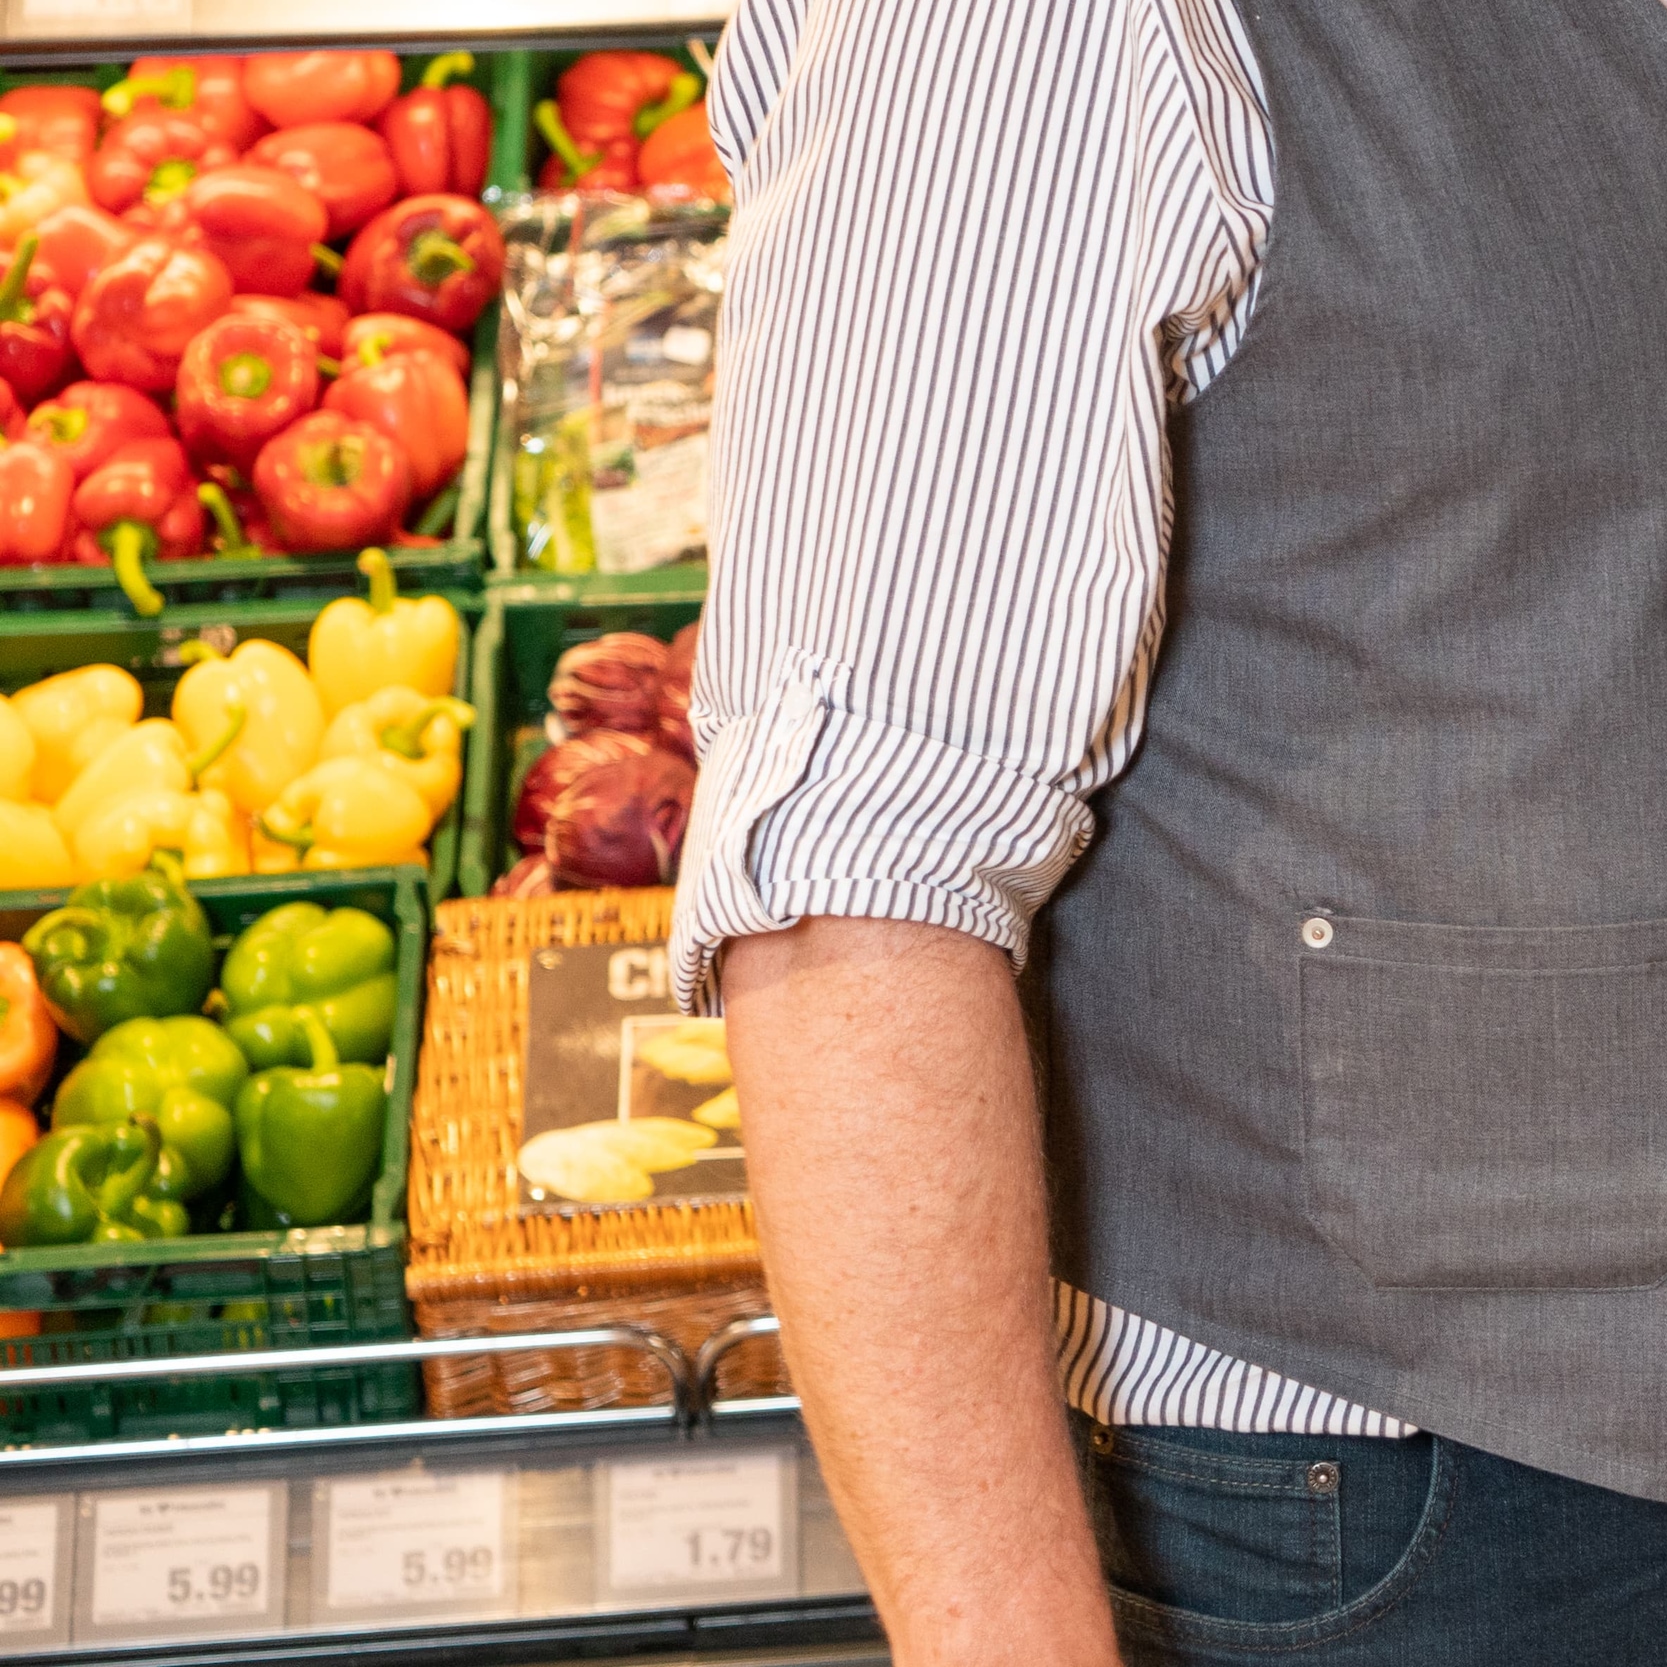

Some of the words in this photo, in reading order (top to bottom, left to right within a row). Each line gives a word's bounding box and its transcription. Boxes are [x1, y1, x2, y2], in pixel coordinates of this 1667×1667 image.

[402, 1545, 494, 1586] 5.99
[685, 1528, 773, 1567] 1.79
[167, 1562, 260, 1605] 5.99
